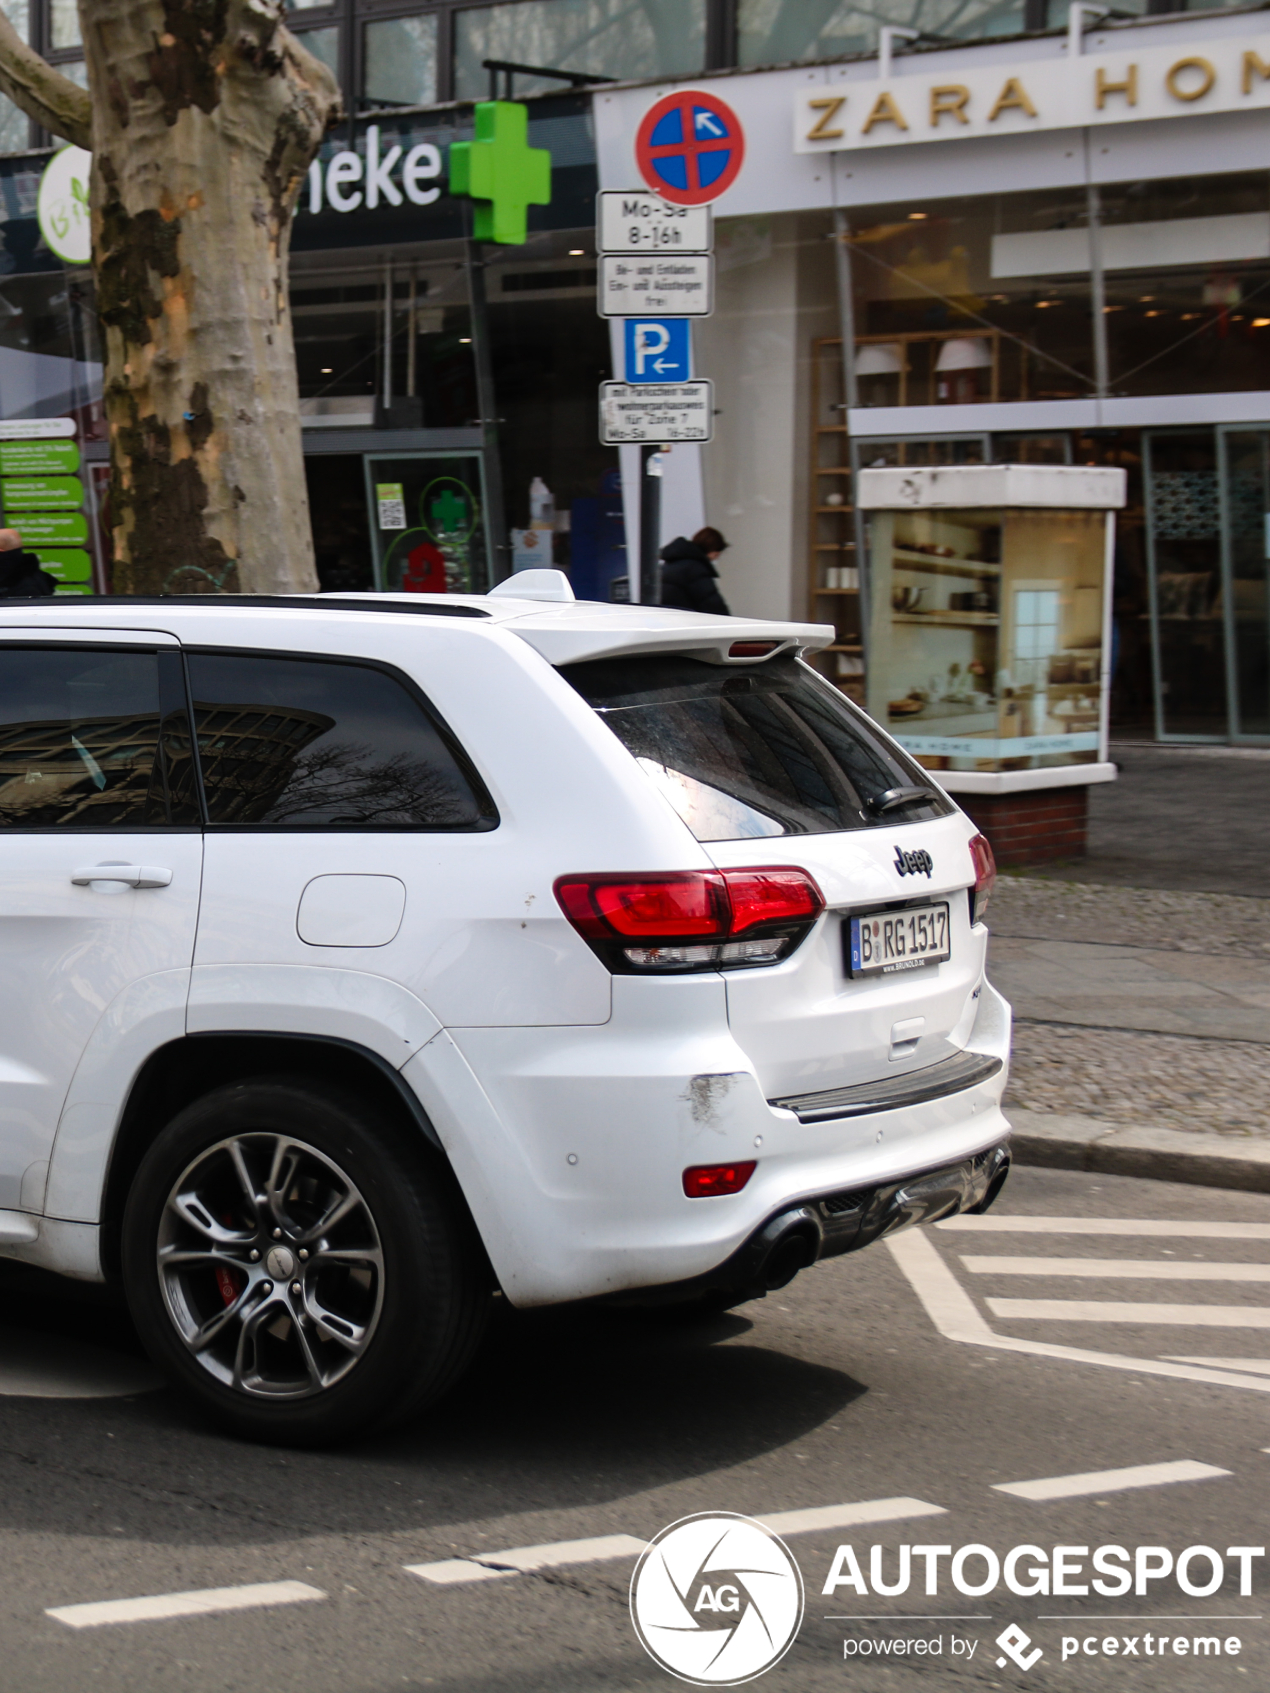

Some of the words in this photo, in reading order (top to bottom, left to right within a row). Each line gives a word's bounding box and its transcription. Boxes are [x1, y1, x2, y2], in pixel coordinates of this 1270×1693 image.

[806, 77, 1038, 140] ZARA
[622, 200, 688, 218] Mo-Sa
[628, 226, 683, 245] 8-16h
[615, 264, 633, 275] Be-
[637, 264, 654, 275] und
[656, 264, 696, 275] Entladen
[632, 281, 650, 291] und
[653, 281, 703, 293] Aussteigen
[644, 296, 667, 307] frei
[634, 323, 670, 375] P
[630, 386, 678, 397] Parkschein
[624, 414, 644, 425] für
[647, 413, 677, 425] Zone
[607, 428, 647, 439] Mo-Sa
[893, 845, 934, 879] Jeep
[861, 923, 873, 962] B
[883, 918, 906, 959] RG
[908, 911, 947, 954] 1517
